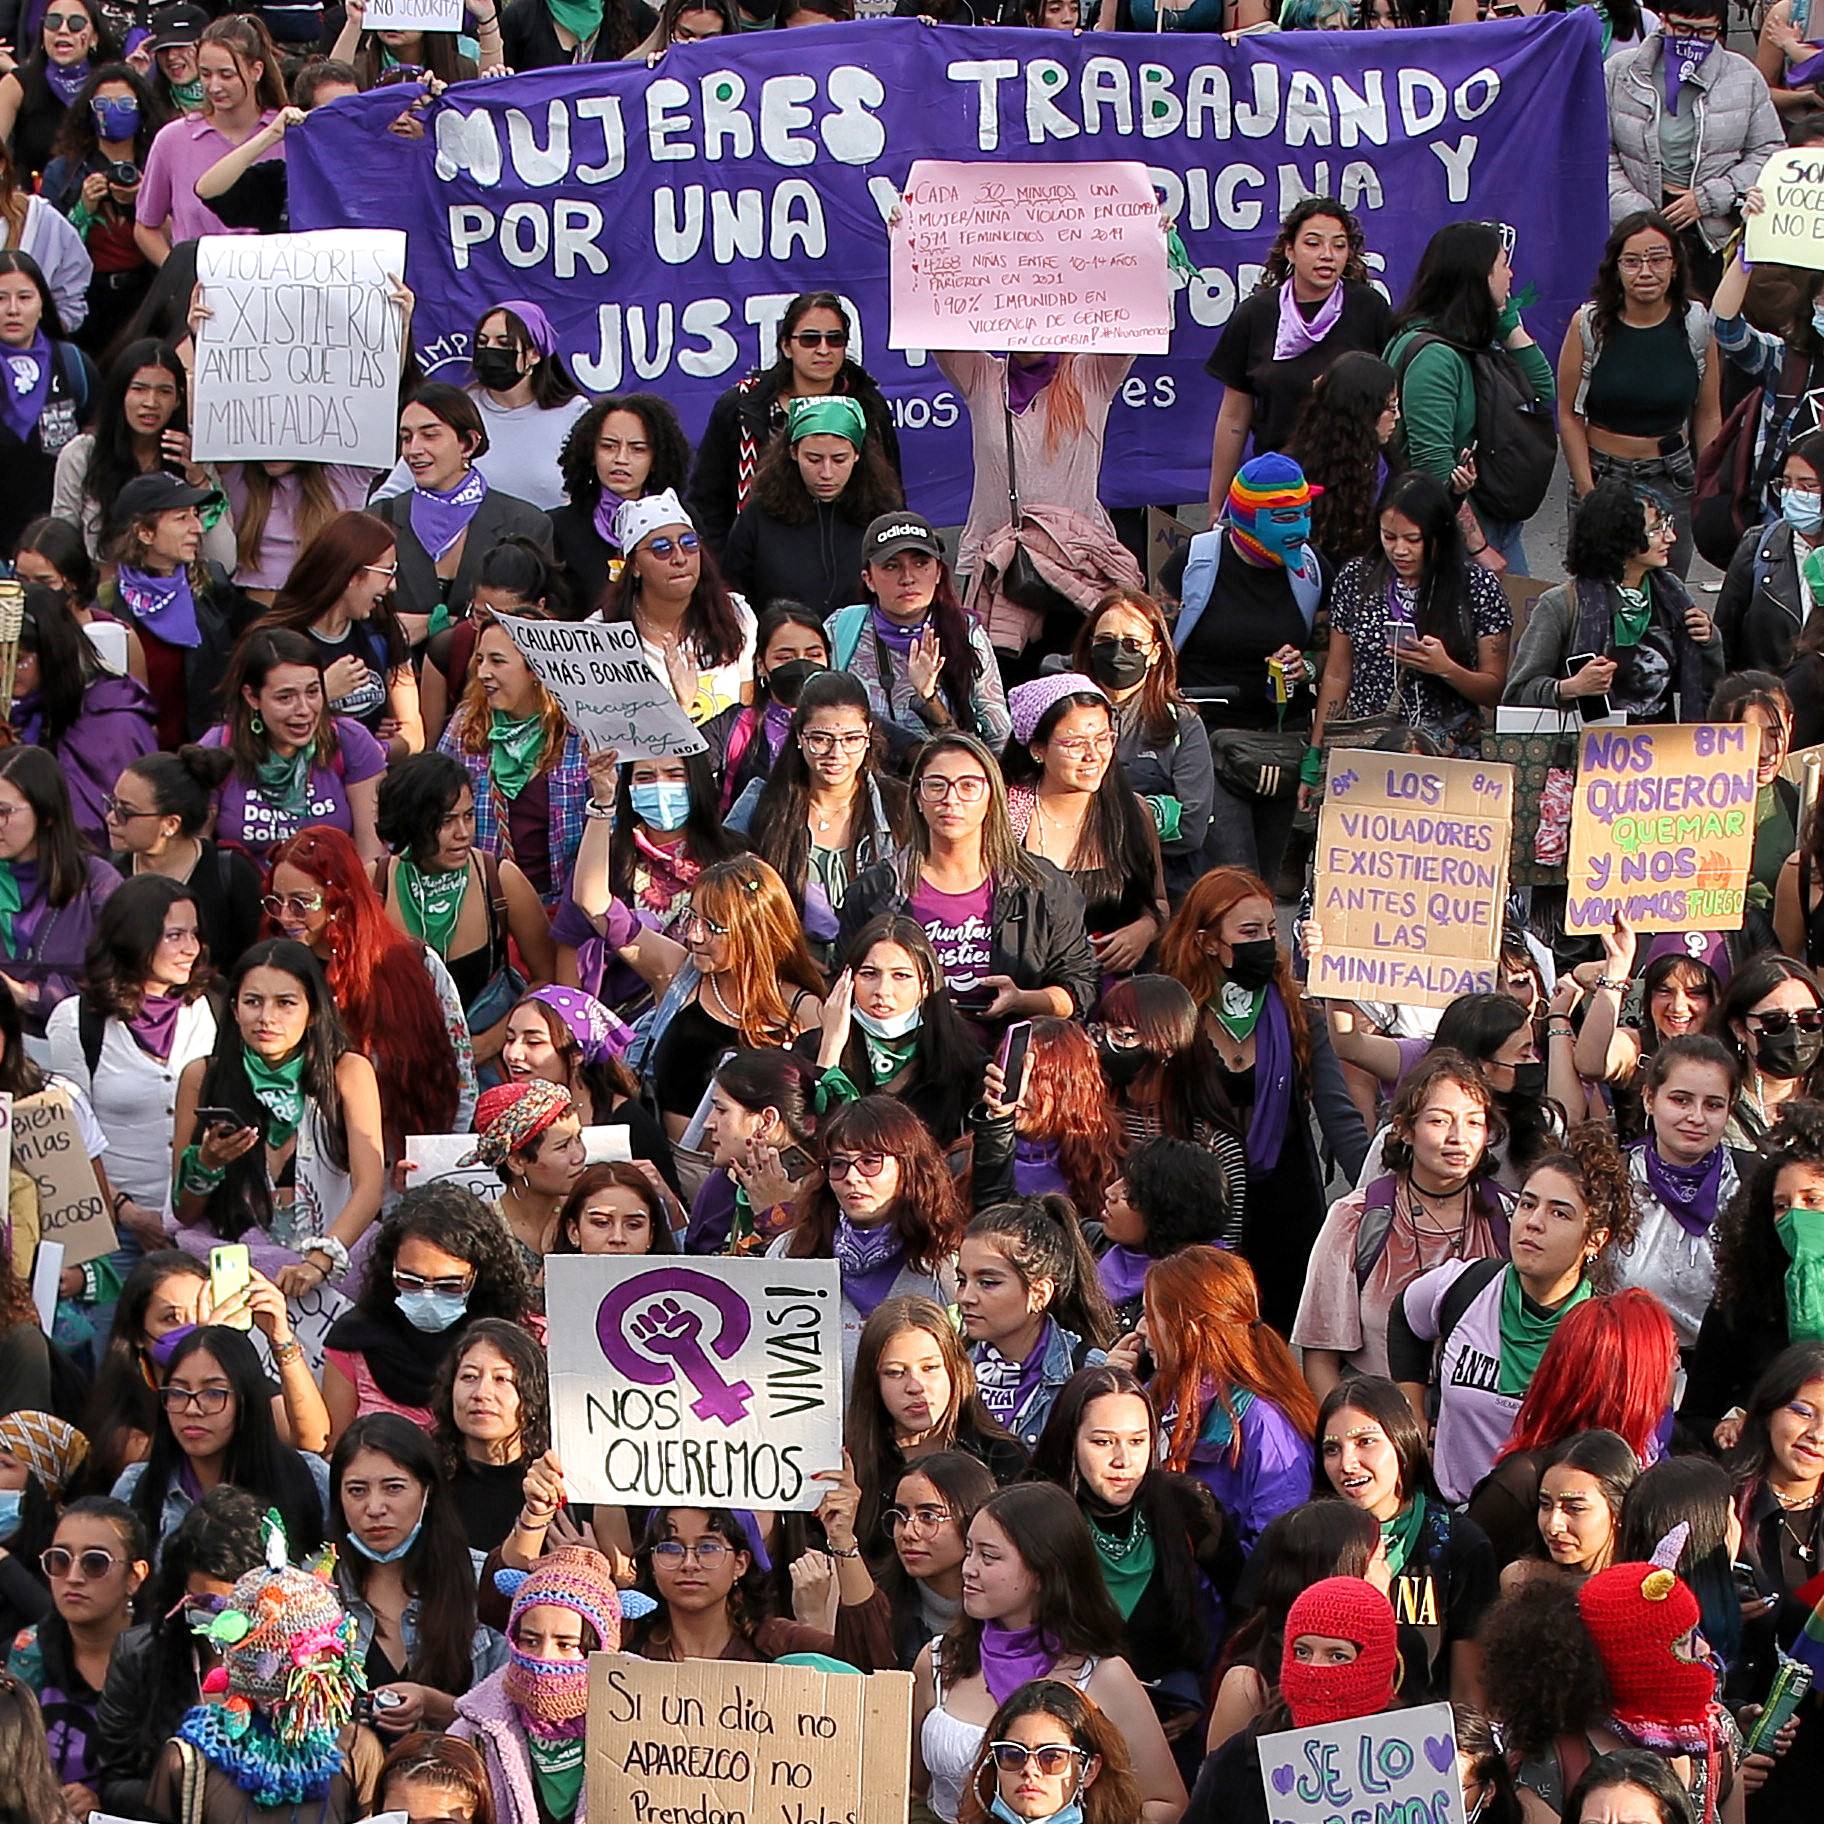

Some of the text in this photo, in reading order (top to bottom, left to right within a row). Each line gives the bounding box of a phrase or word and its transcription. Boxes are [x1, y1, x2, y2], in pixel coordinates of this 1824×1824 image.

[435, 56, 1501, 188] MUJERES TRABAJANDO
[450, 136, 1477, 278] POR UNA Y
[1090, 184, 1119, 197] UNA
[1770, 214, 1807, 238] NO
[205, 248, 388, 286] VIOLADORES
[1018, 255, 1059, 269] ENTRE
[200, 284, 403, 352] EXISTIERON
[994, 294, 1078, 310] IMPUNIDAD
[200, 345, 385, 389] ANTES QUE LAS
[206, 394, 360, 449] MINIFALDAS
[876, 521, 928, 543] adidas
[517, 625, 637, 653] CALLADITA NO
[547, 658, 660, 686] MÁS BONITA
[1581, 723, 1746, 774] NOS 8M
[1331, 767, 1505, 806] 8M LOS 8M
[1585, 766, 1755, 825] QUISIERON
[1339, 811, 1494, 852] VIOLADORES
[1610, 810, 1745, 854] QUEMAR
[1327, 847, 1496, 890] EXISTIERON
[1622, 846, 1698, 884] NOS
[1326, 887, 1490, 927] ANTES QUE
[1684, 886, 1746, 920] FUEGO
[1372, 922, 1429, 951] LAS
[1319, 953, 1495, 995] MINIFALDAS
[586, 1286, 828, 1433] NOS VIVAS!
[605, 1439, 804, 1503] QUEREMOS
[662, 1699, 838, 1740] un no
[623, 1741, 812, 1790] APAREZCO no
[1297, 1733, 1416, 1805] SE LO
